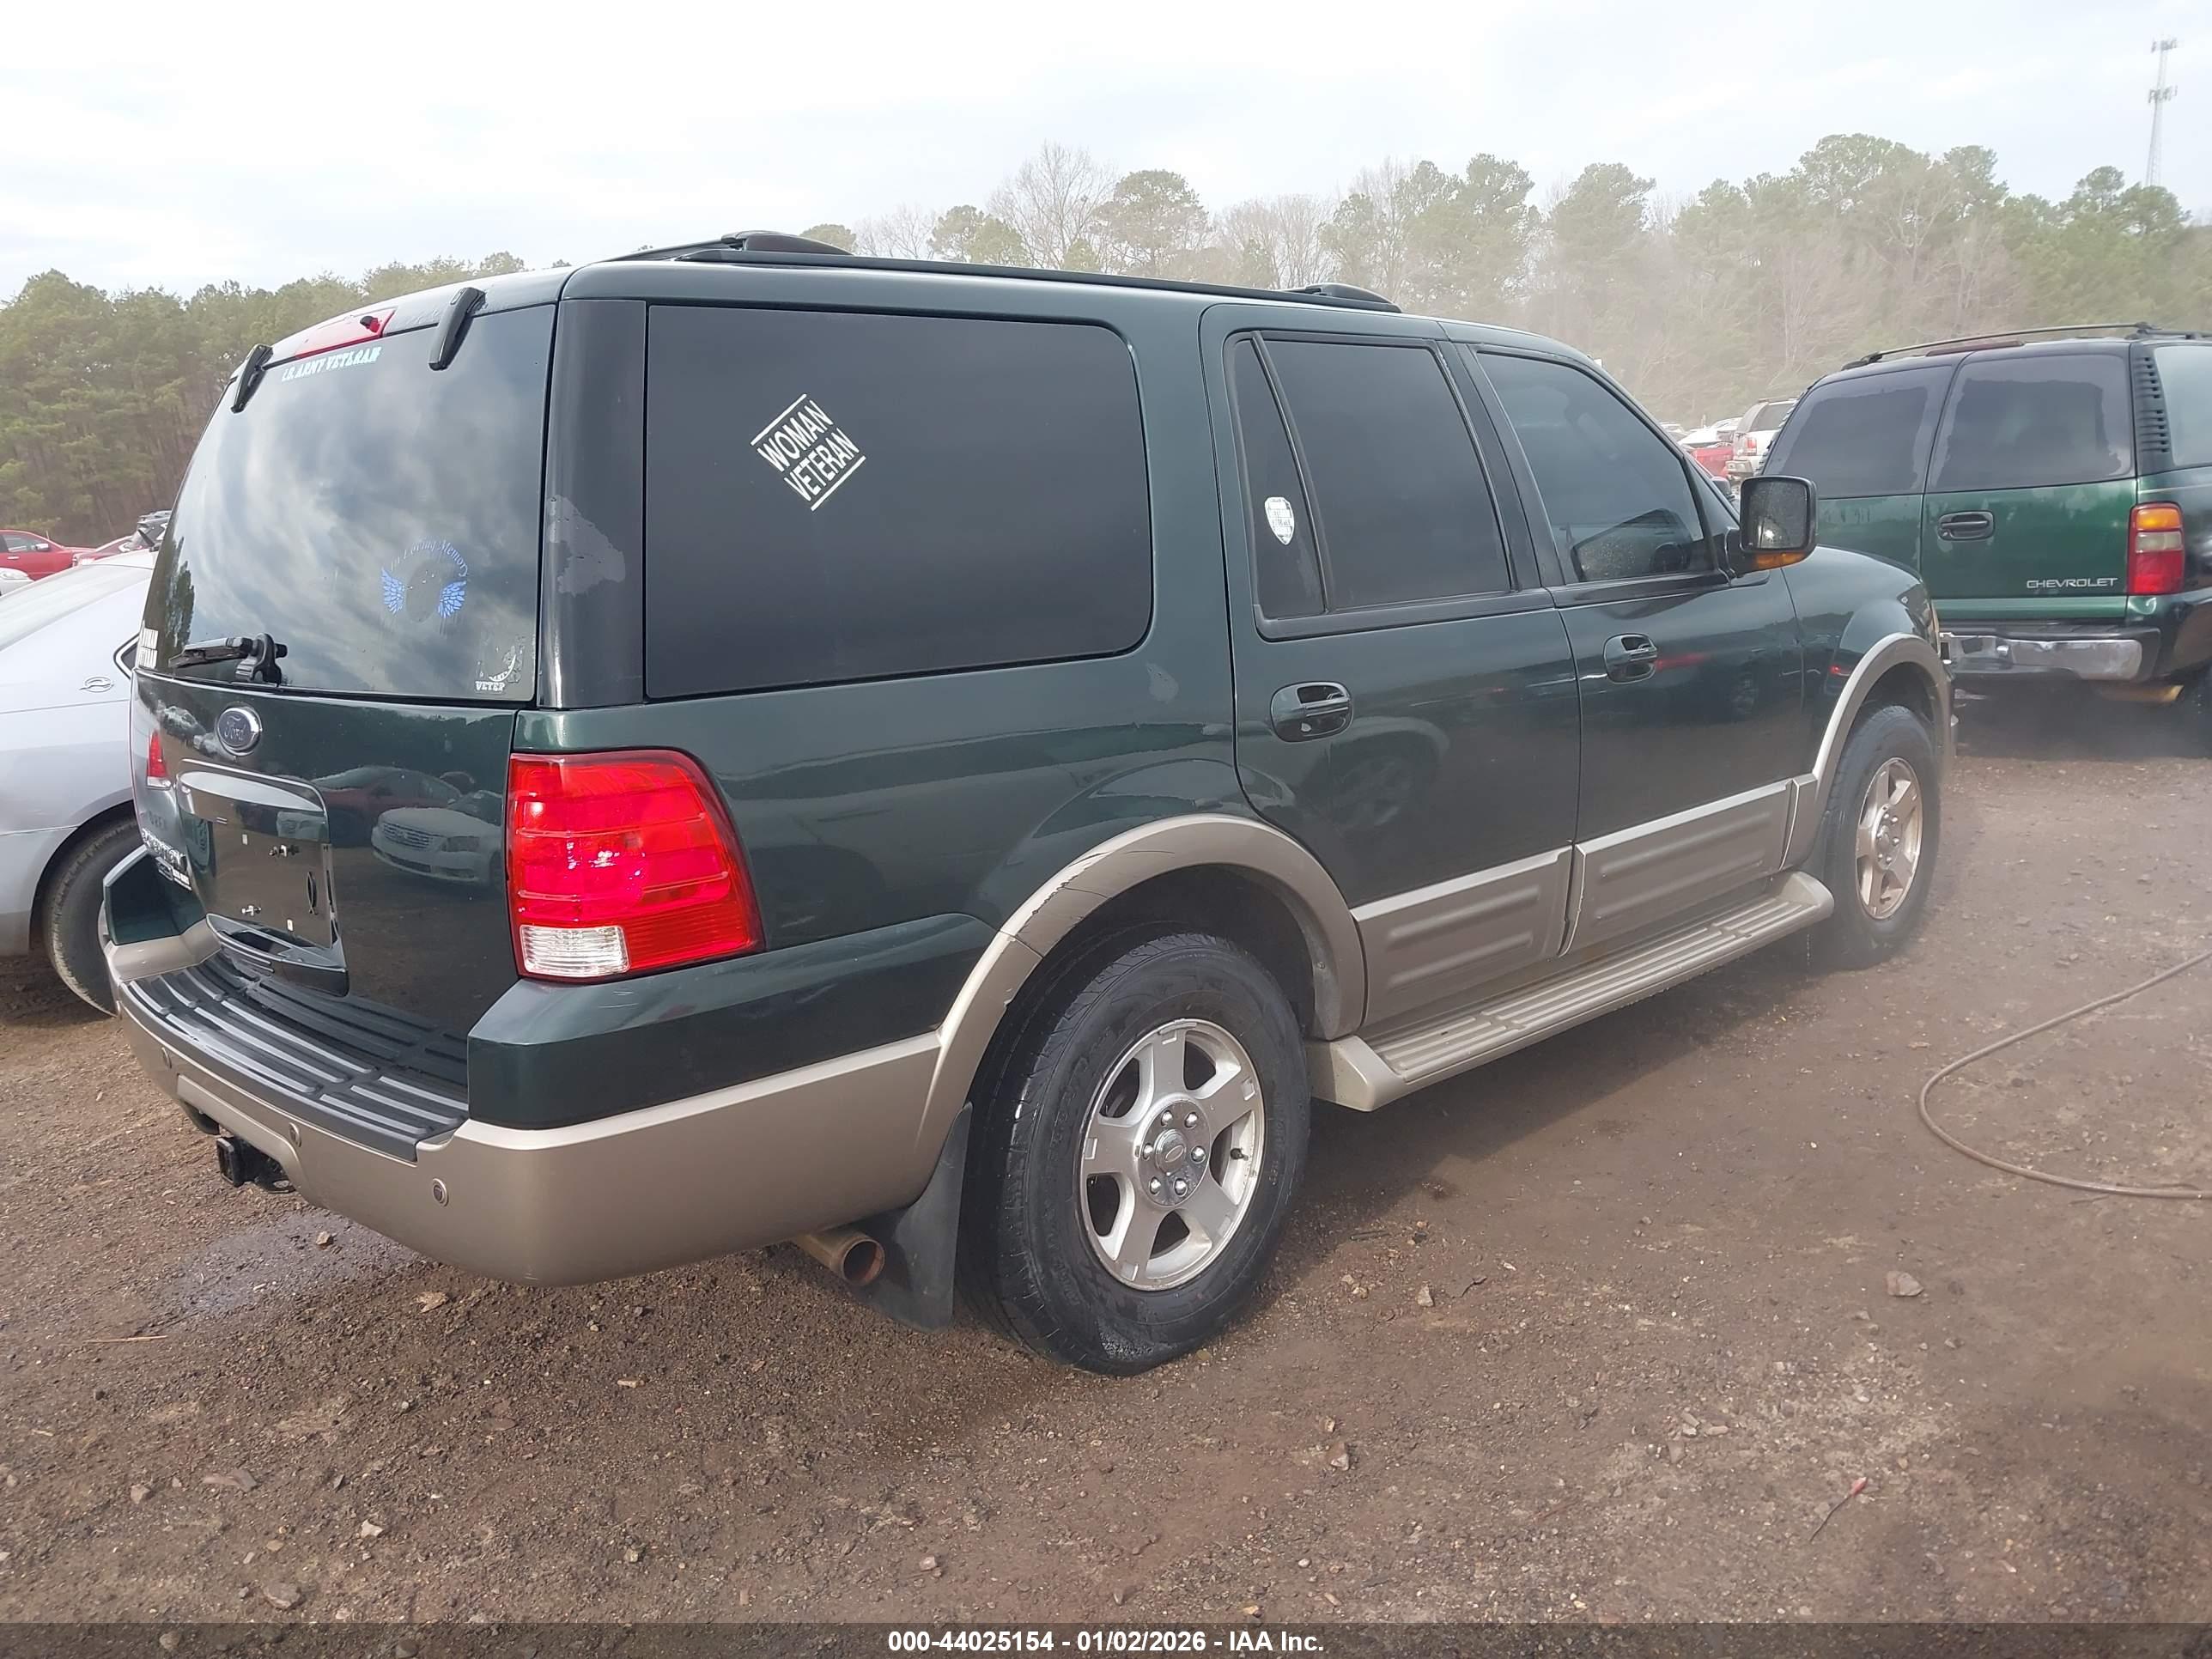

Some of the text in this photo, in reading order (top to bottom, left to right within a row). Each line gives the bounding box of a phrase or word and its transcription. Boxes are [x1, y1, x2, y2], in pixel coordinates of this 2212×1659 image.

[757, 399, 834, 472] WOMAN
[783, 427, 860, 501] VETERAN
[2026, 577, 2119, 589] CHEVROLET
